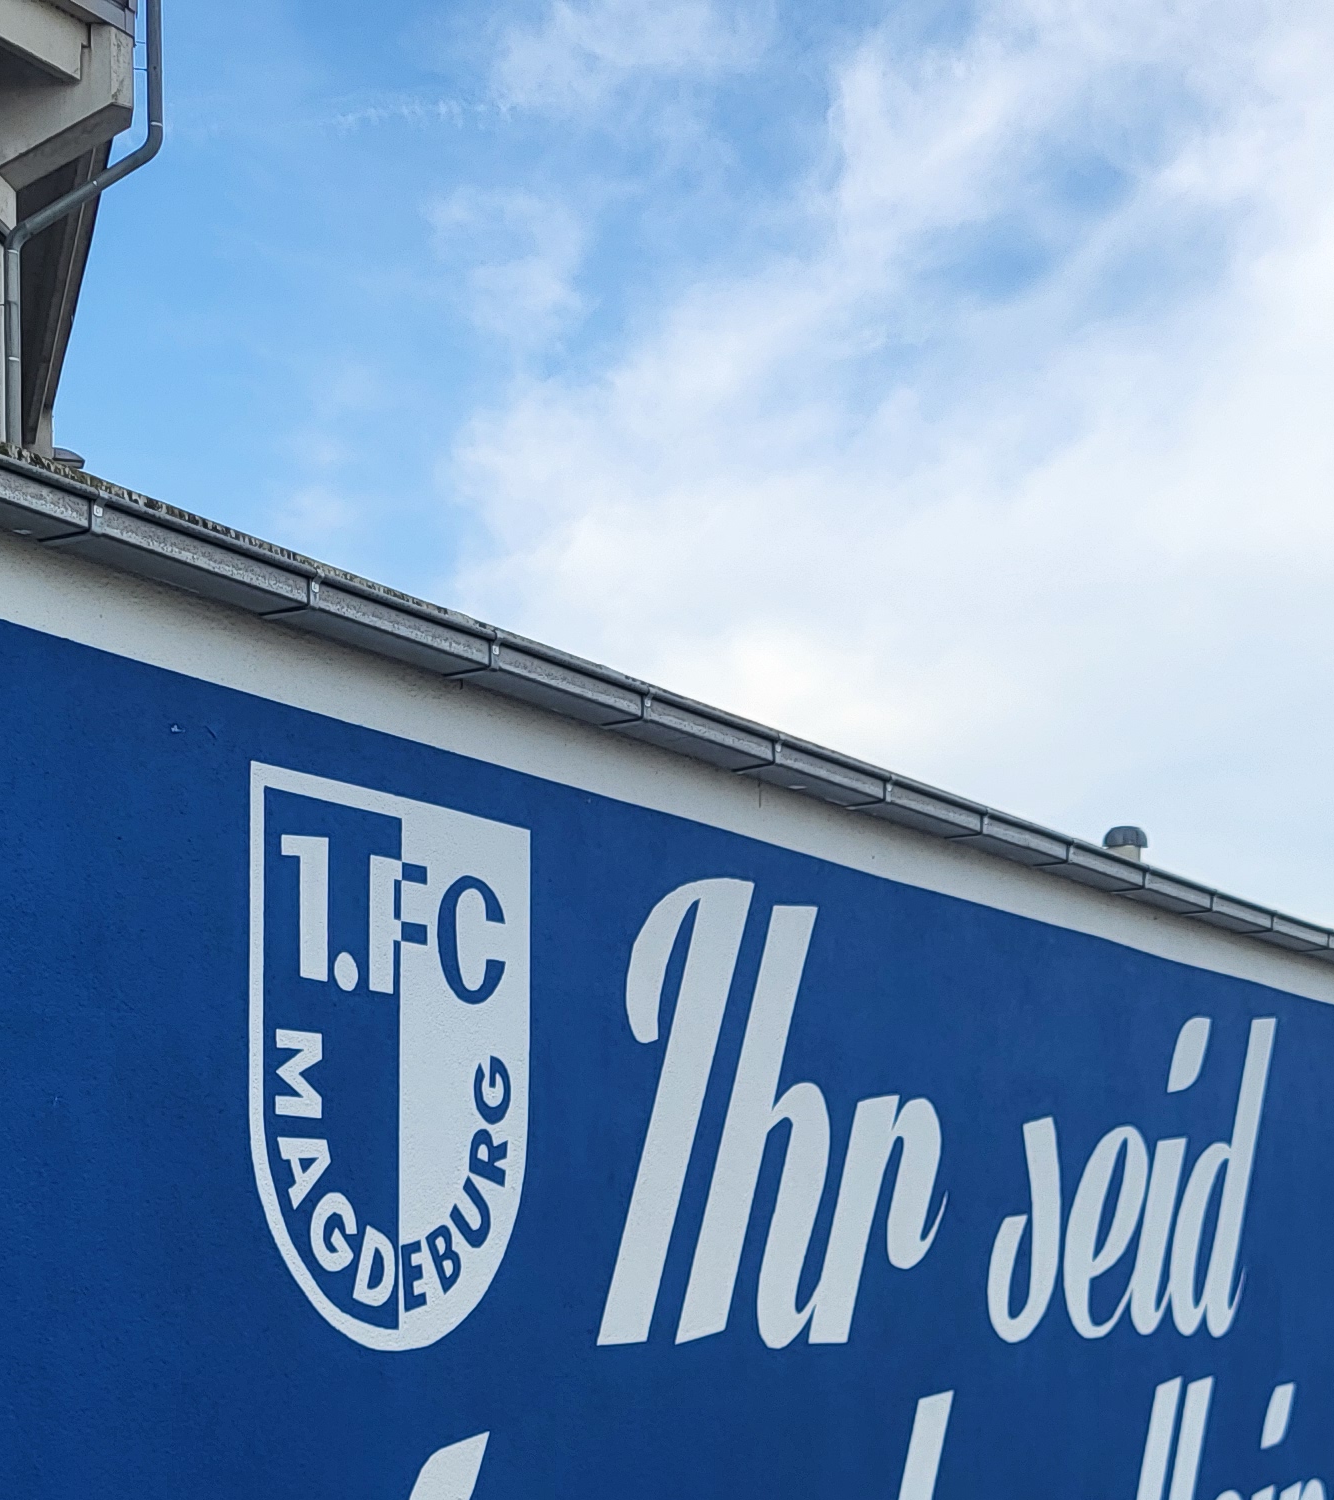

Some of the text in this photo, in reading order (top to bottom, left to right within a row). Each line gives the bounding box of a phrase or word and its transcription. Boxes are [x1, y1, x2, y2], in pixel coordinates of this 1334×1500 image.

[275, 1026, 513, 1312] MAGDEBURG
[596, 876, 1278, 1350] Ihr seid
